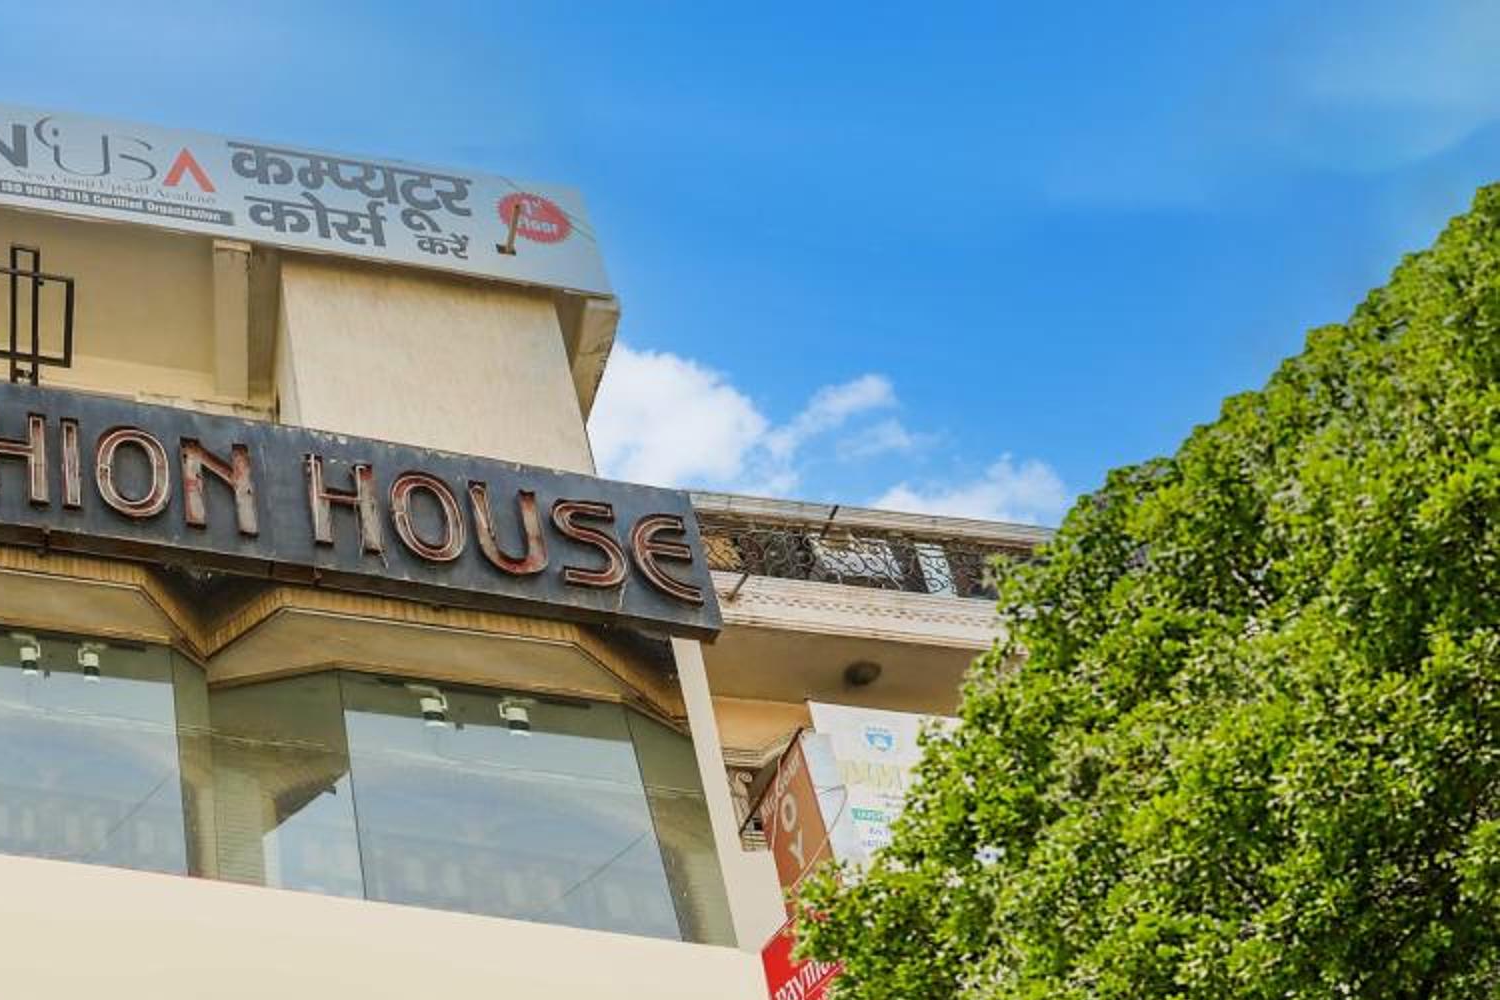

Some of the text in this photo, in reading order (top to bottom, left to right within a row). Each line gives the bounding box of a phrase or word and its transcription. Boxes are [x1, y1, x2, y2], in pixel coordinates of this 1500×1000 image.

[2, 181, 22, 194] ISO
[93, 193, 143, 211] Certified
[244, 191, 387, 247] कोर्स
[306, 451, 704, 607] HOUSE
